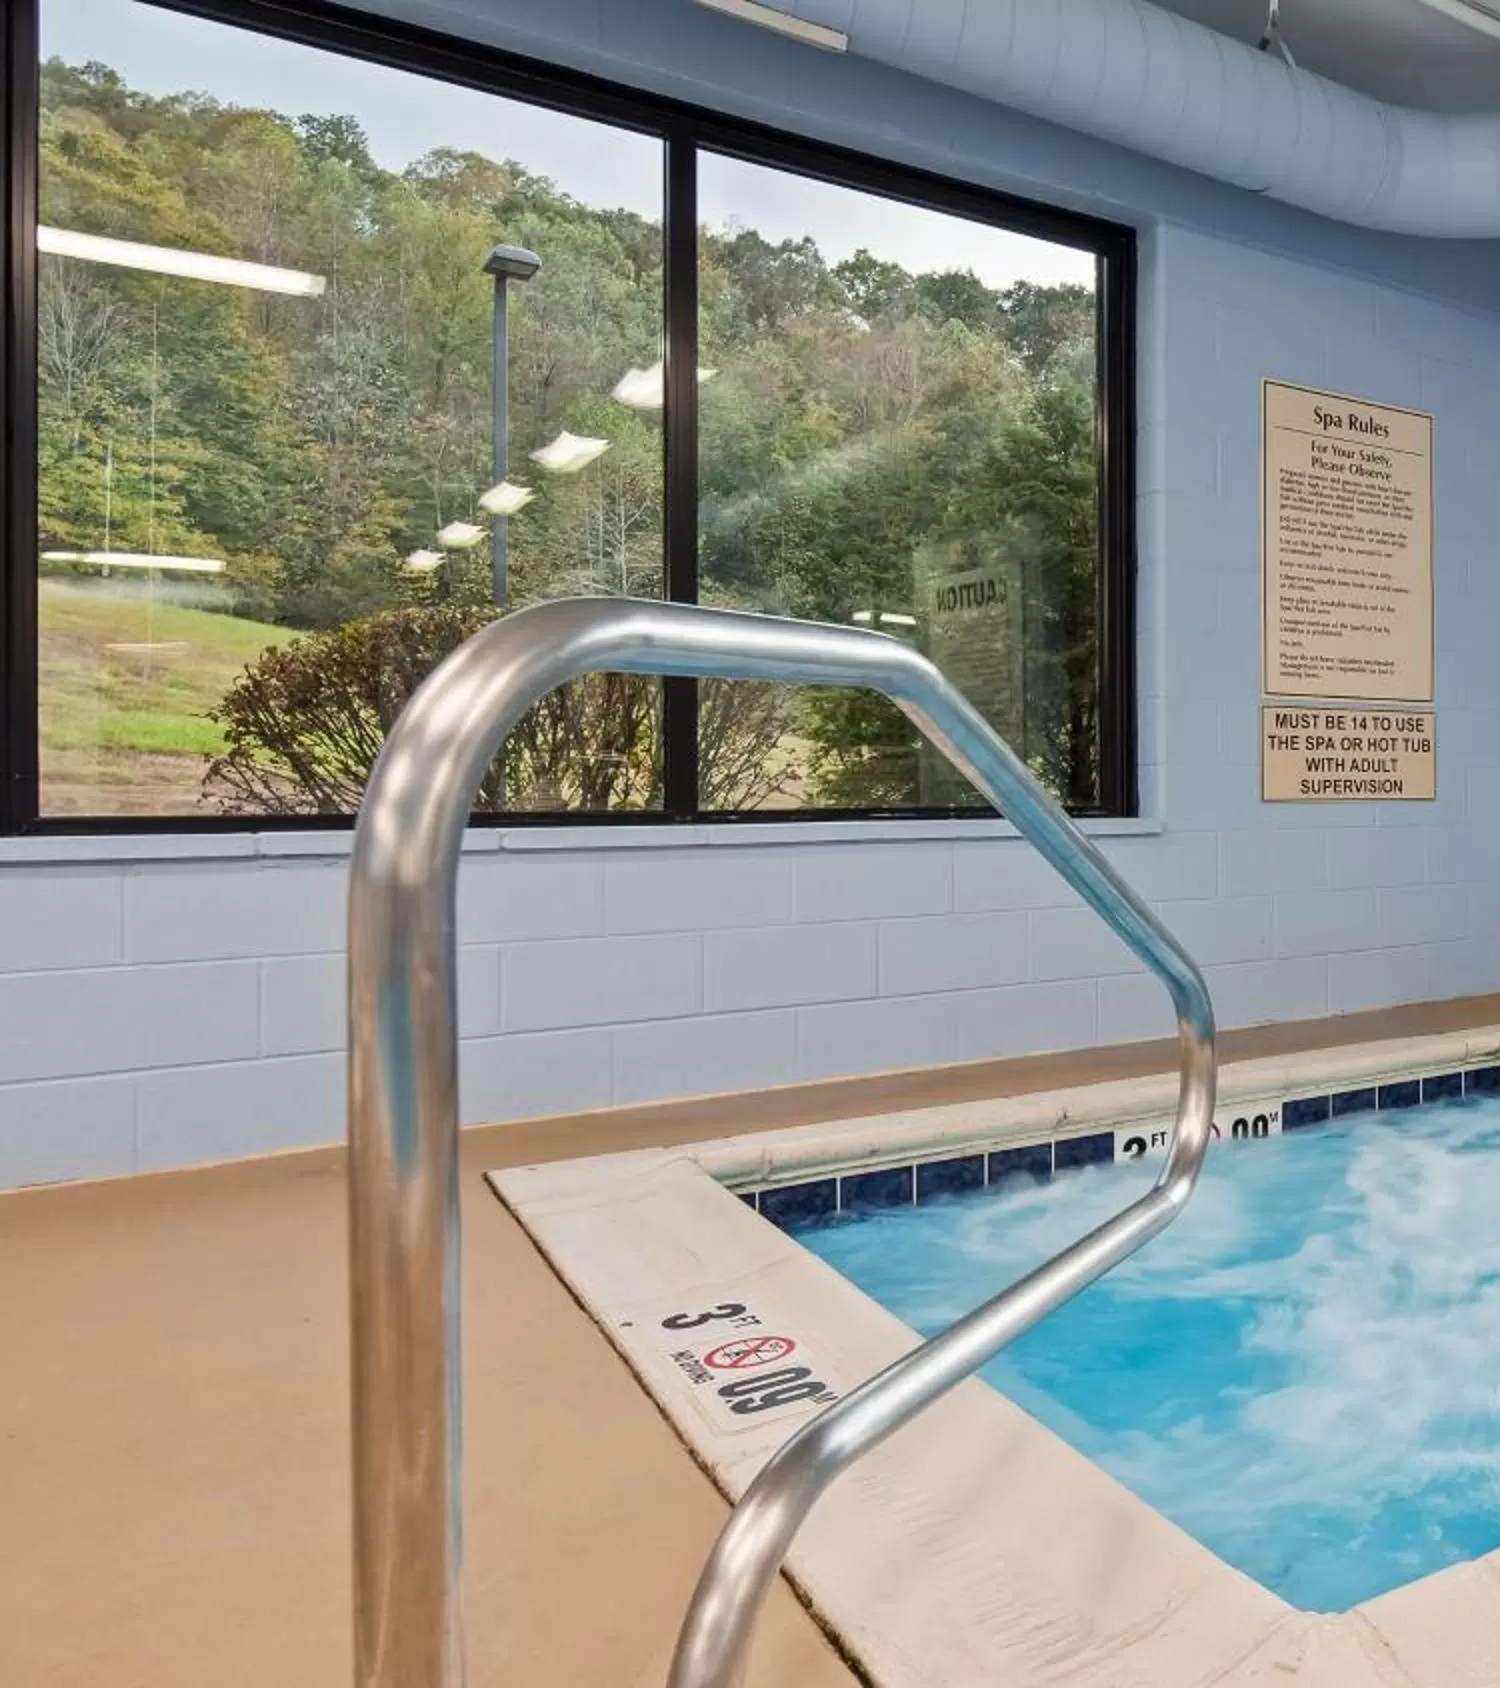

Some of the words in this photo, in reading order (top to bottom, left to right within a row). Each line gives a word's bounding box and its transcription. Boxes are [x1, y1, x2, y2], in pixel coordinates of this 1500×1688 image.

[1313, 405, 1343, 431] Spa
[1349, 413, 1390, 439] Rules
[1311, 439, 1329, 453] For
[1331, 443, 1355, 459] Your
[1359, 450, 1393, 469] Safety,
[1311, 455, 1345, 474] Please
[1349, 463, 1393, 482] Observe
[1275, 713, 1320, 729] MUST
[1325, 715, 1346, 730] BE
[1352, 716, 1367, 731] 14
[1372, 717, 1391, 731] TO
[1395, 718, 1425, 733] USE
[1268, 735, 1300, 750] THE
[1305, 736, 1335, 751] SPA
[1340, 737, 1363, 751] OR
[1367, 738, 1399, 752] HOT
[1403, 738, 1431, 753] TUB
[1306, 757, 1345, 772] WITH
[1350, 758, 1399, 773] ADULT
[1300, 779, 1403, 794] SUPERVISION
[661, 1303, 747, 1329] 3
